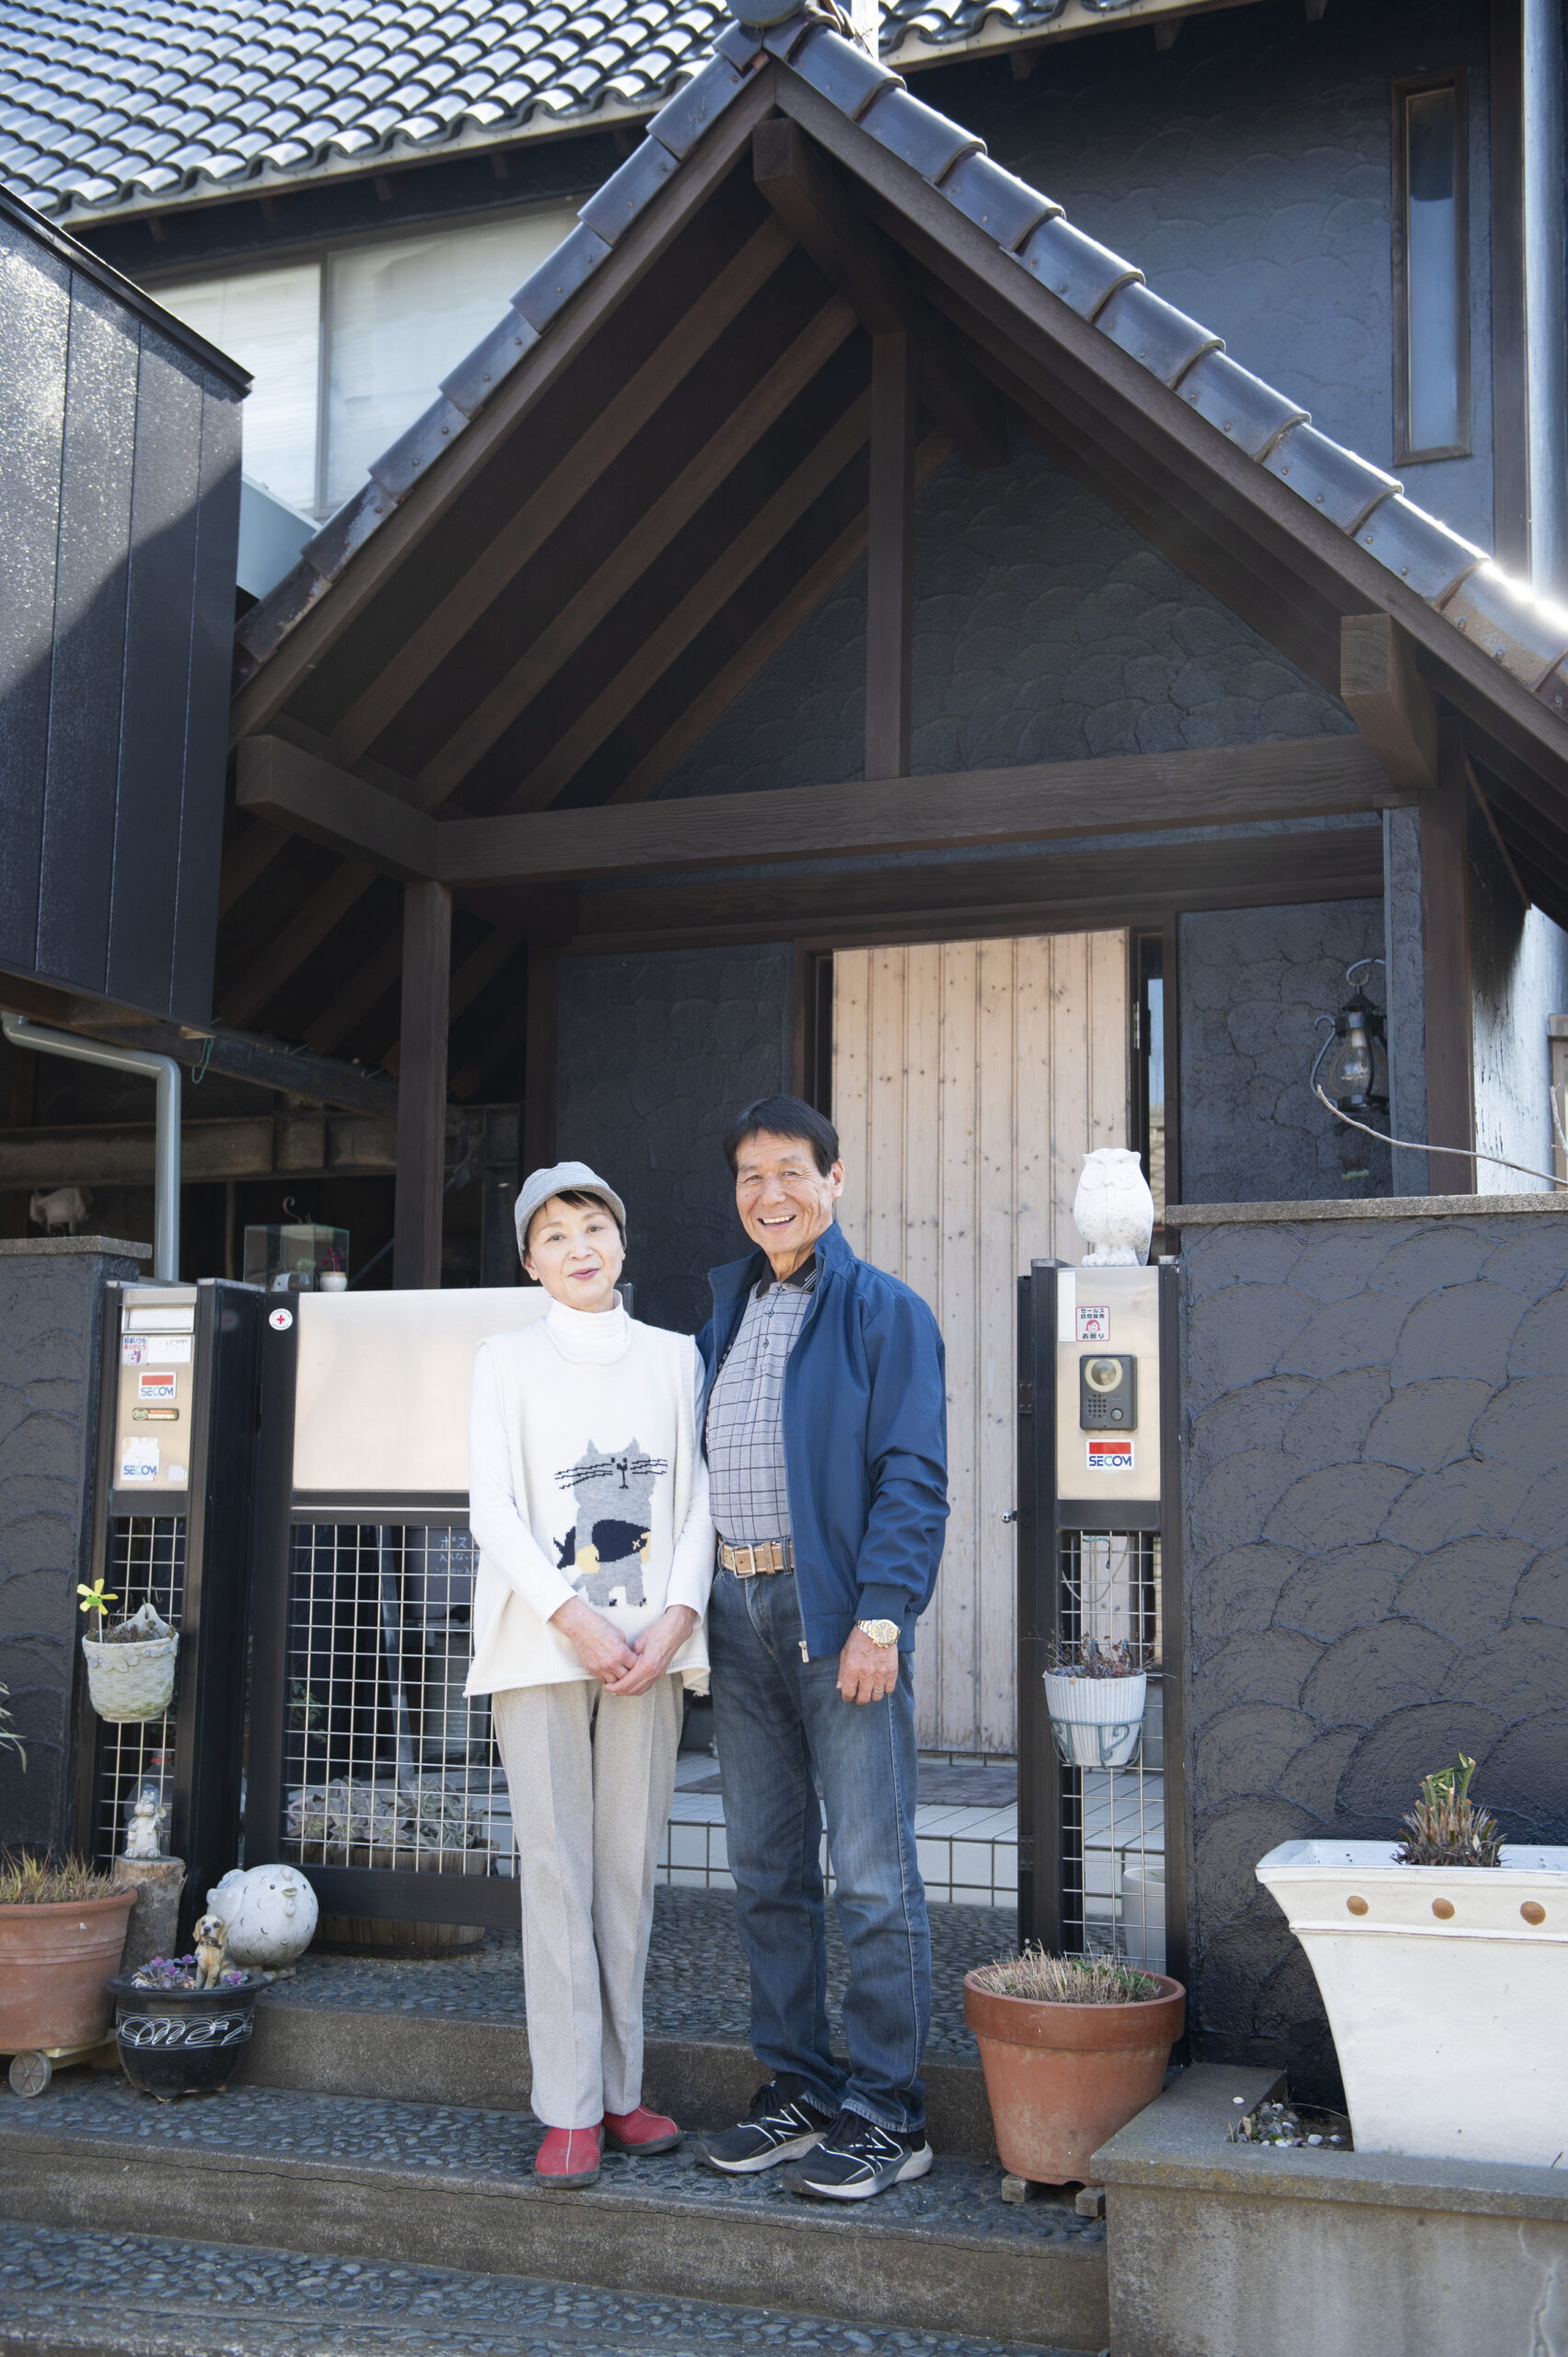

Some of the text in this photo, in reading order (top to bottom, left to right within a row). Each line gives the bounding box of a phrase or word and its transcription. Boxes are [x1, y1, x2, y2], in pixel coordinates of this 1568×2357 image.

[141, 1387, 174, 1397] SECOM
[1089, 1456, 1132, 1467] SECOM
[123, 1466, 157, 1475] SECOM
